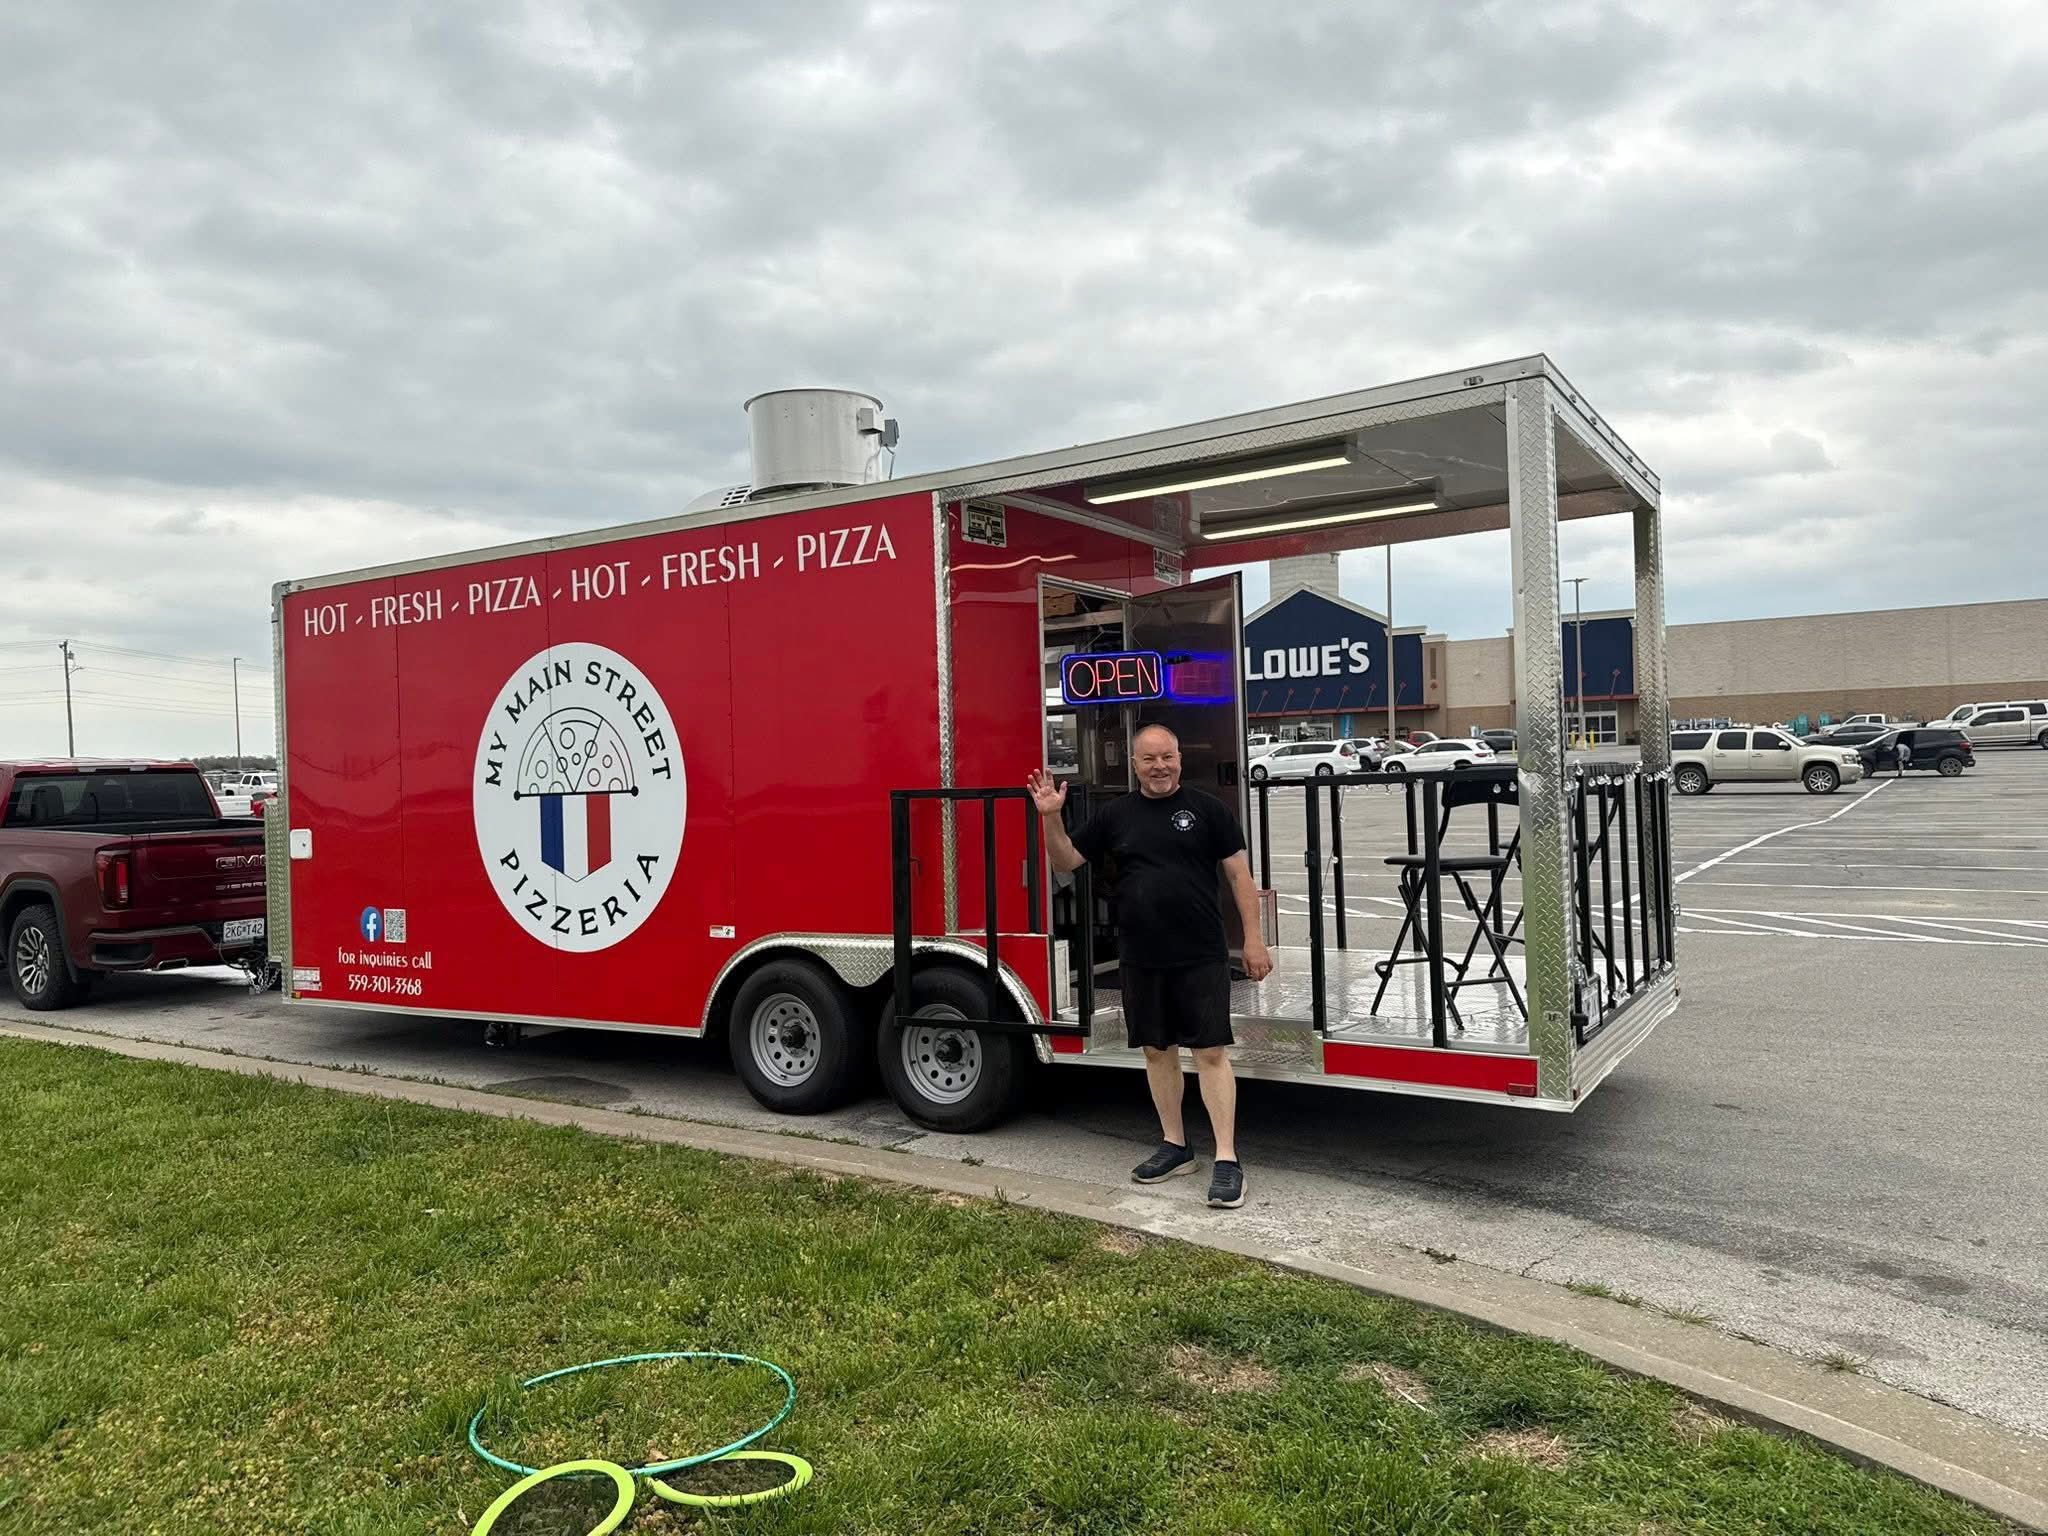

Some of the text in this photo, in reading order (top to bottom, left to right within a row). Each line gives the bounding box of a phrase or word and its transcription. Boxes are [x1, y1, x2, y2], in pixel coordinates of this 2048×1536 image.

[304, 603, 348, 636] HOT
[371, 589, 442, 629] FRESH
[469, 576, 541, 615] PIZZA
[571, 561, 631, 602] HOT
[662, 543, 760, 590] FRESH
[798, 523, 897, 571] PIZZA
[1069, 657, 1159, 697] OPEN
[1245, 637, 1370, 680] LOWE'S
[486, 660, 672, 787] MY MAIN STREET
[216, 881, 267, 891] SIERR
[500, 848, 660, 935] PIZZERIA
